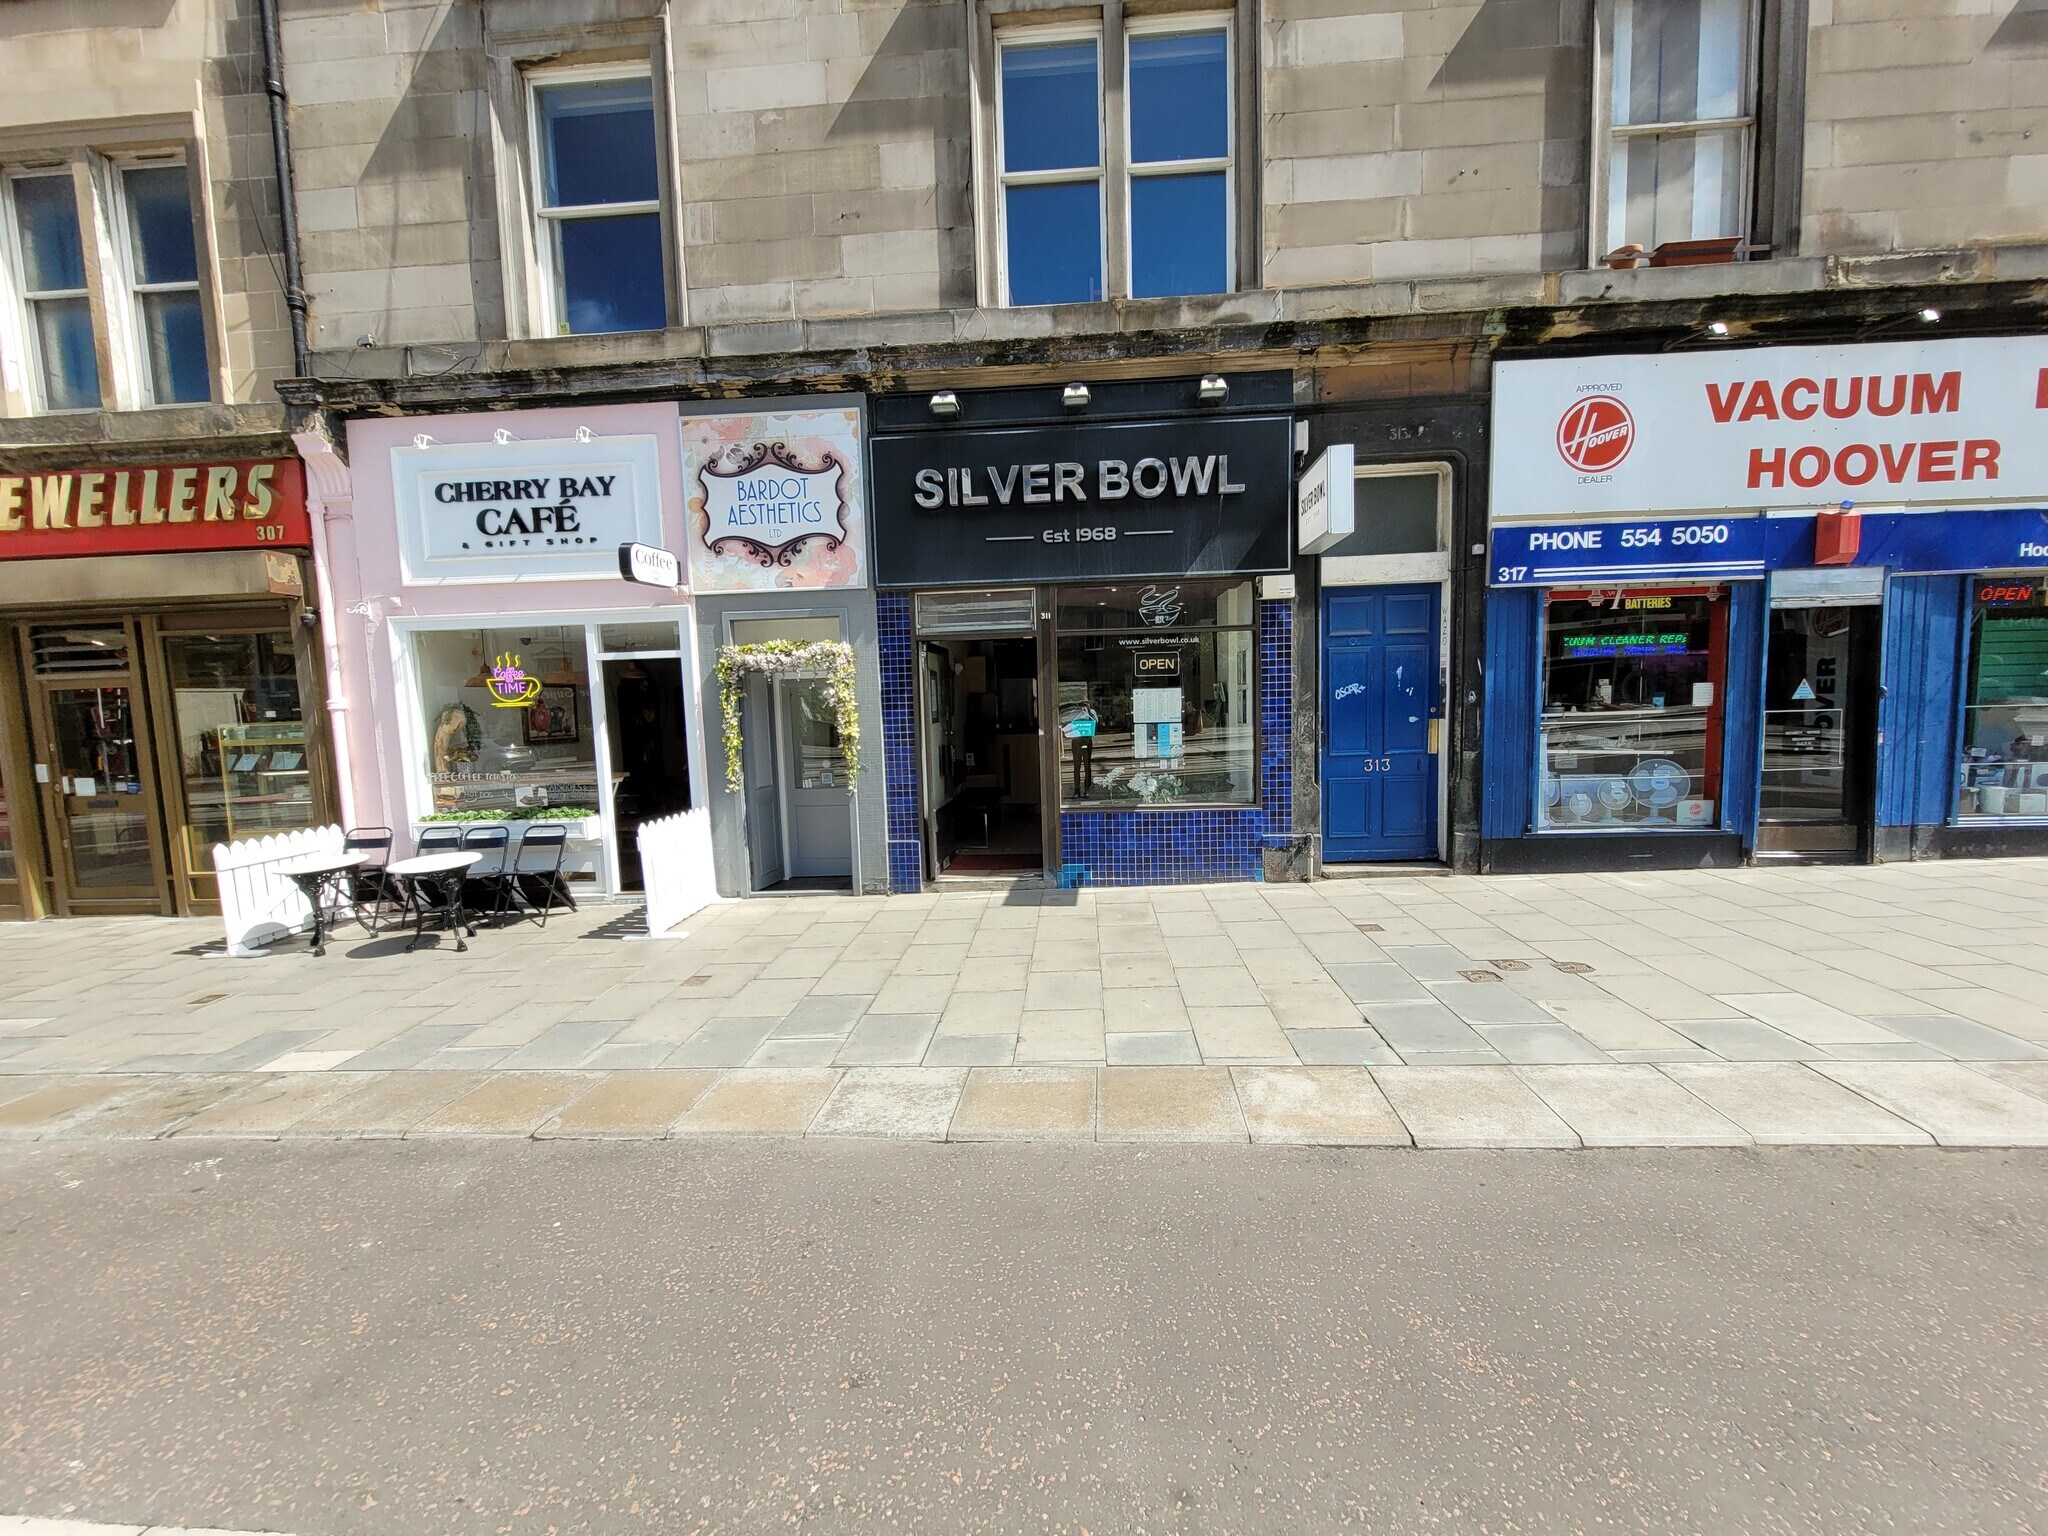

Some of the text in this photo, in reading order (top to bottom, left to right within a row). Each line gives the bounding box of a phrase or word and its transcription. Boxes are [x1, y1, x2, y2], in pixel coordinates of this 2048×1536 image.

[1576, 382, 1622, 393] APPROVED
[1705, 371, 1961, 423] VACUUM
[1746, 439, 2000, 489] HOOVER
[914, 454, 1246, 510] SILVER BOWL
[1577, 475, 1613, 485] DEALER
[434, 475, 616, 503] CHERRY BAY
[737, 477, 808, 501] BARDOT
[476, 498, 580, 536] CAFÉ
[728, 501, 822, 526] AESTHETICS
[256, 525, 284, 541] 307
[769, 528, 782, 538] LTD
[1042, 526, 1117, 543] Est 1968
[1529, 524, 1728, 550] PHONE 554 5050
[485, 539, 530, 548] GIFT
[546, 537, 598, 546] SHOP
[635, 548, 673, 571] Coffee
[1498, 566, 1528, 582] 317
[1980, 586, 2033, 601] OPEN
[1625, 597, 1672, 610] BATTERIES
[1040, 612, 1051, 620] 311
[1119, 636, 1200, 645] www.silverbowl.co.uk
[1600, 635, 1656, 645] CLEANER
[1139, 658, 1175, 670] OPEN
[493, 667, 525, 682] Coffee
[495, 681, 526, 694] TIME
[1364, 759, 1391, 772] 313
